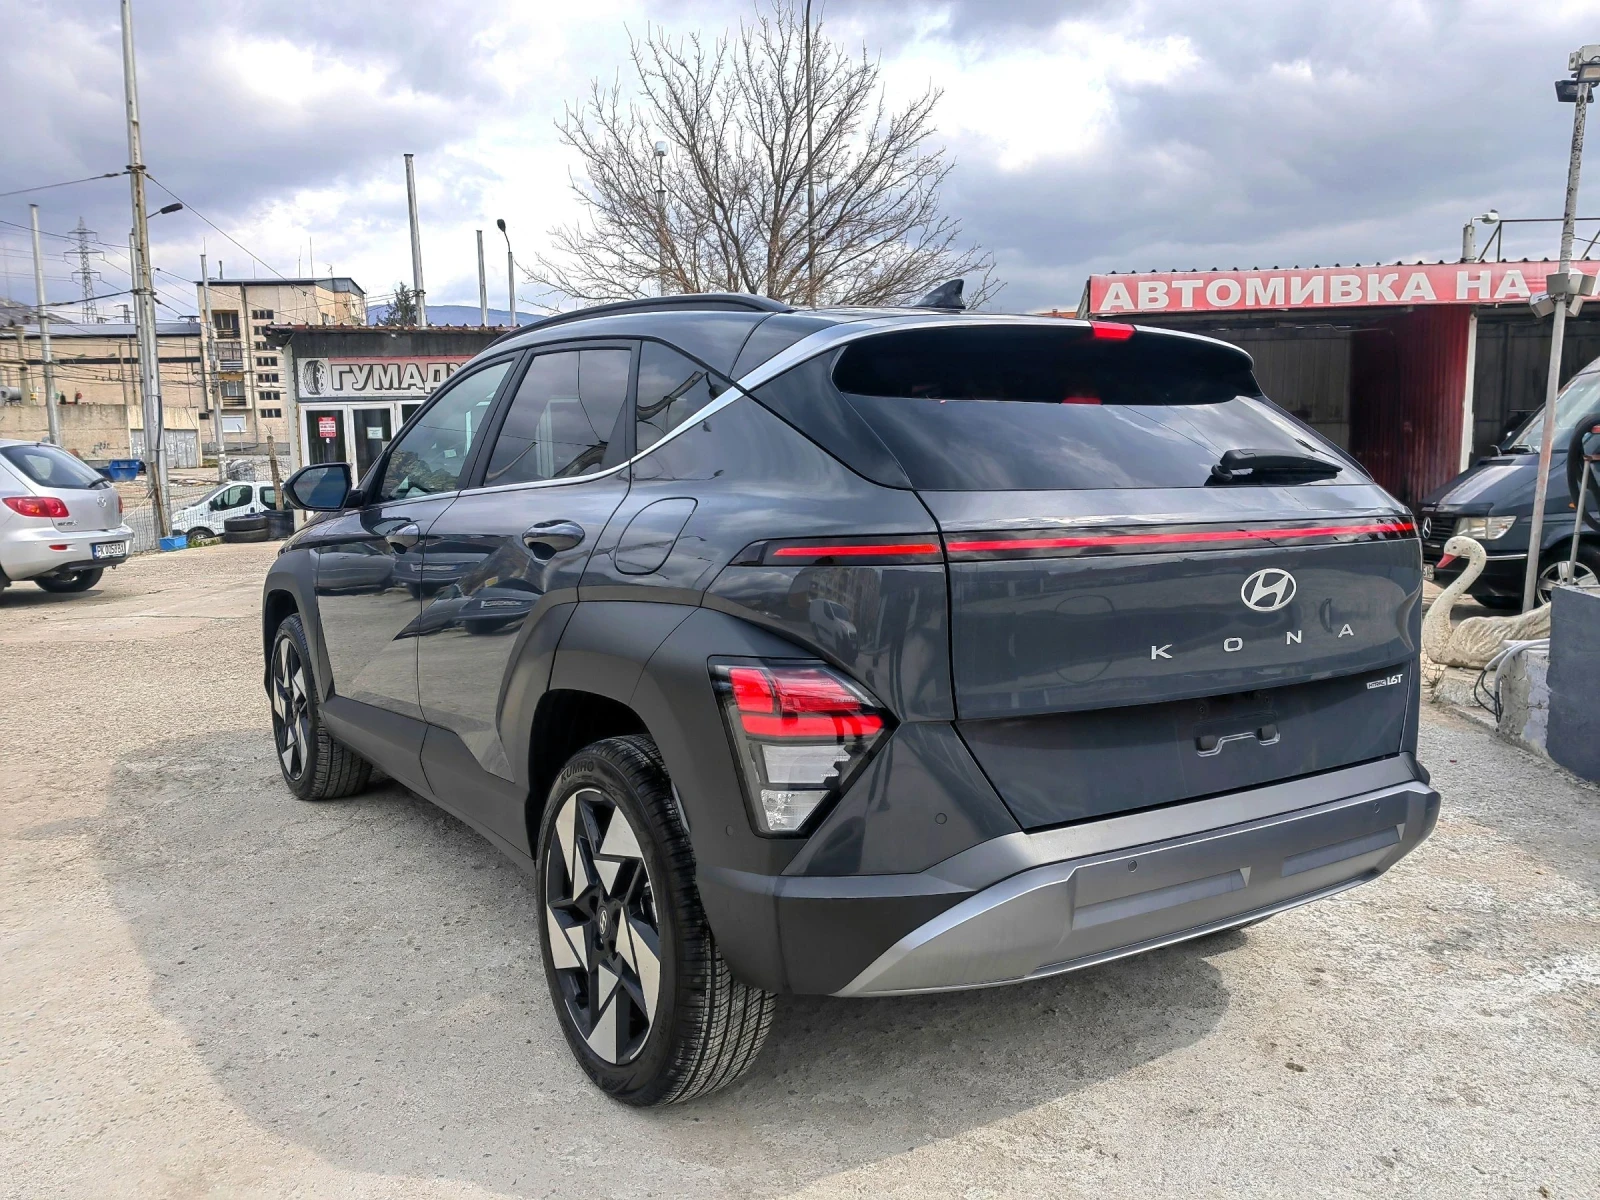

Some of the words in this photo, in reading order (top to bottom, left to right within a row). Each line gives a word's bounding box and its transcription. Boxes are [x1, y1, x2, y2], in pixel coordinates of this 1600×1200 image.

[1099, 271, 1437, 311] АВТОМИВКА
[1455, 269, 1532, 300] НА
[331, 362, 465, 394] ГУМАД
[1150, 623, 1355, 660] KONA
[560, 760, 595, 784] KUMHO
